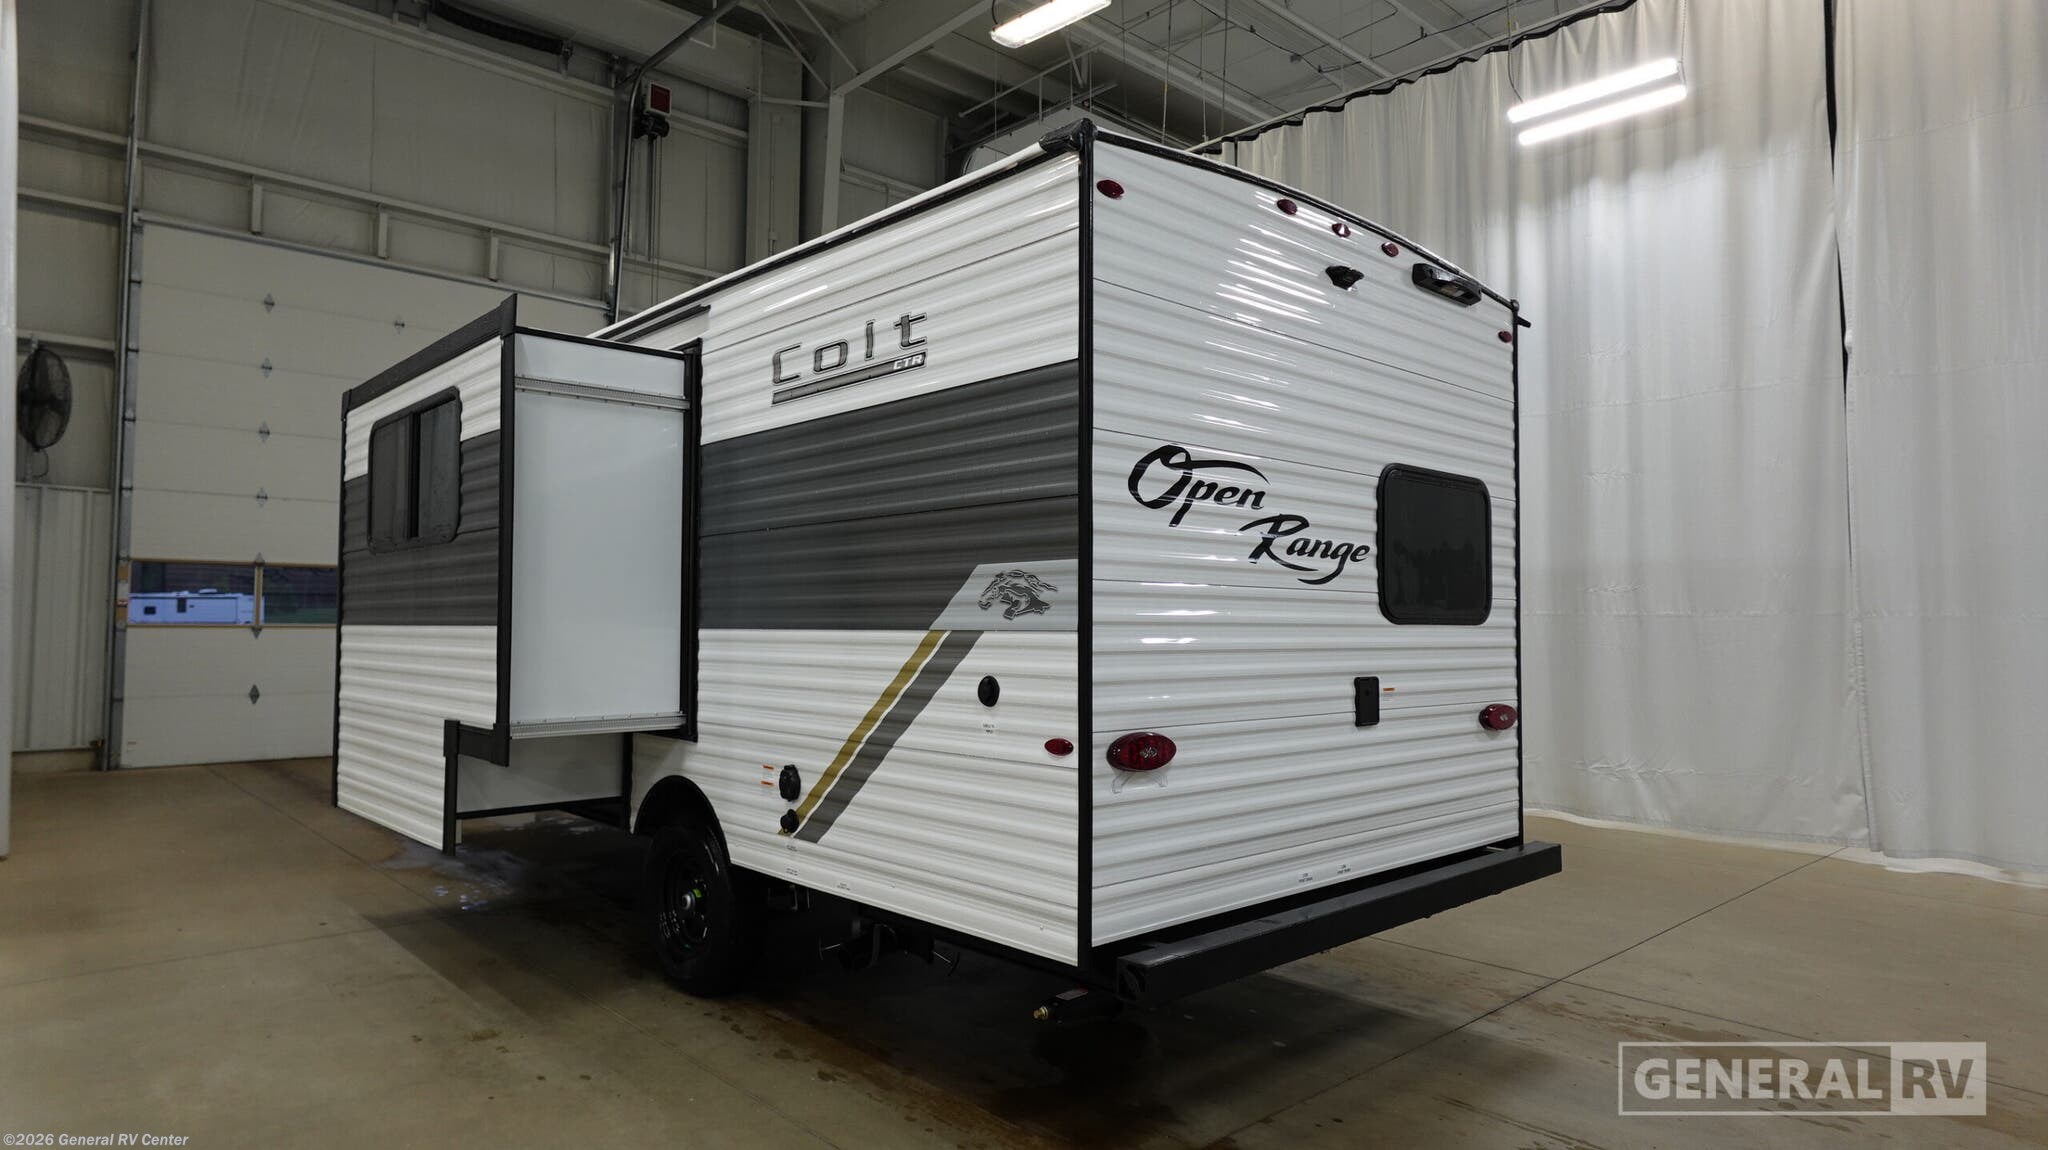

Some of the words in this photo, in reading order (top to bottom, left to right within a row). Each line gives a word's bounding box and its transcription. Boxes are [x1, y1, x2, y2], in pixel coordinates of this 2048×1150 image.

[772, 313, 927, 384] Colt
[893, 354, 923, 371] CTR
[1128, 444, 1271, 528] Open
[1237, 513, 1371, 585] Range
